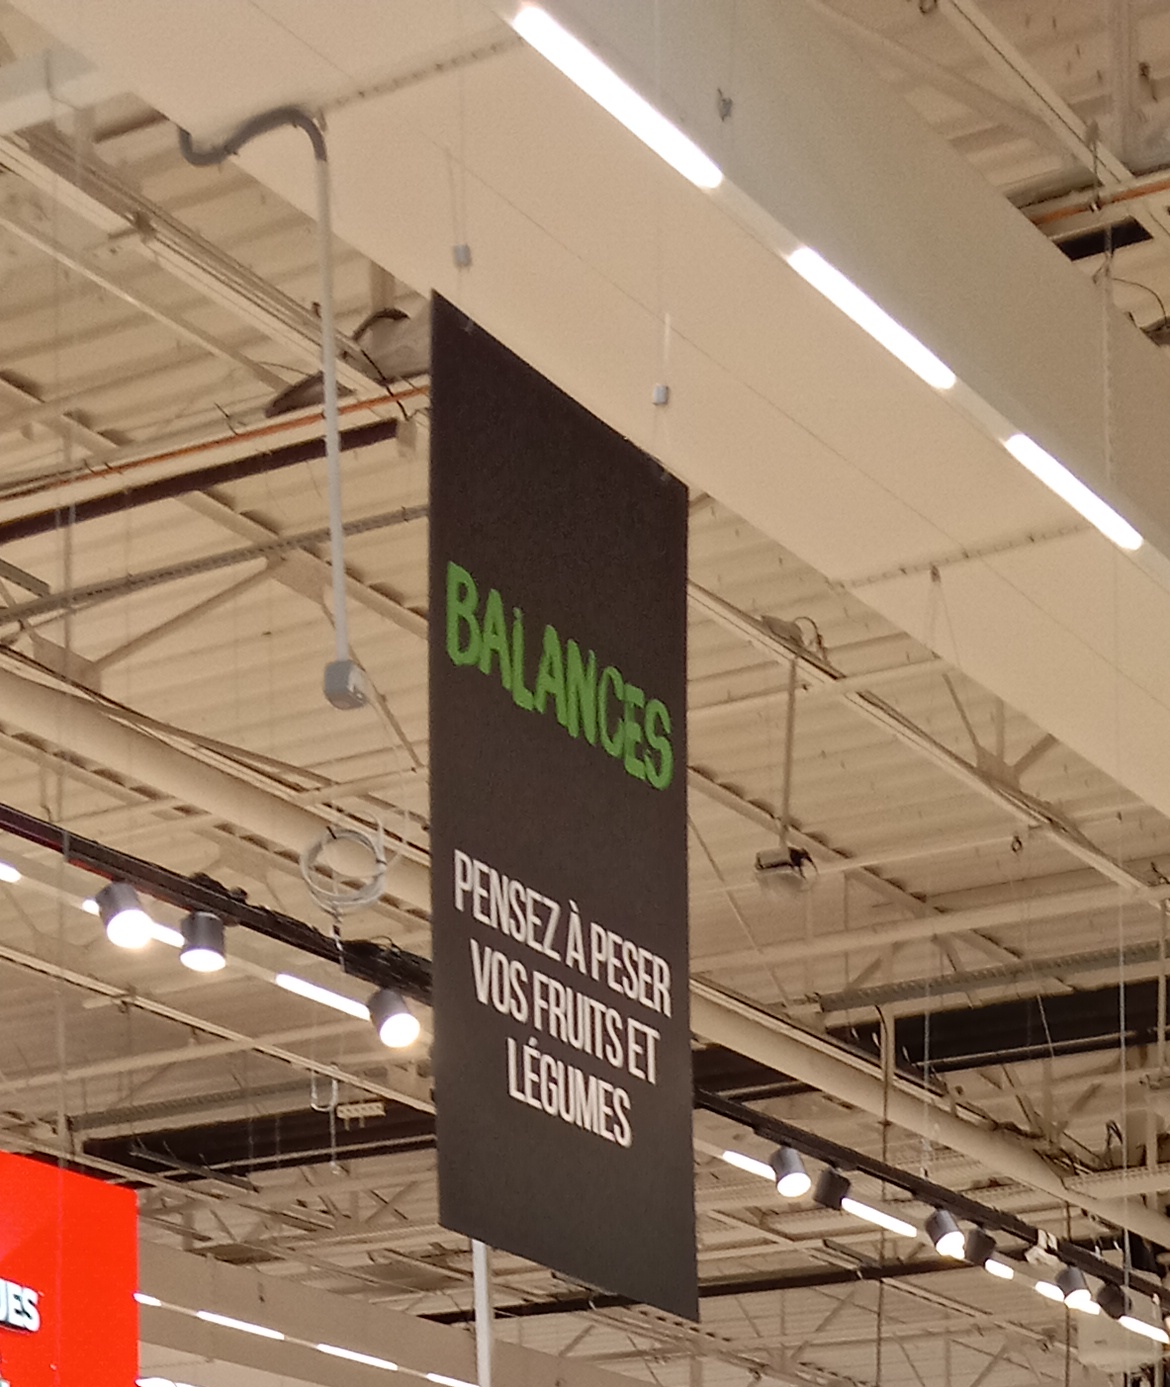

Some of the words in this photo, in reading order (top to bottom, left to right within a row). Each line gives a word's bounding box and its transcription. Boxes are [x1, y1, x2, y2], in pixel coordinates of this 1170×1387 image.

[447, 561, 673, 790] BALANCES
[454, 848, 562, 962] PENSEZ
[565, 899, 587, 975] À
[590, 921, 672, 1018] PESER
[470, 938, 528, 1024] VOS
[532, 970, 623, 1068] FRUITS
[627, 1017, 660, 1085] ET
[507, 1036, 632, 1148] LÉGUMES
